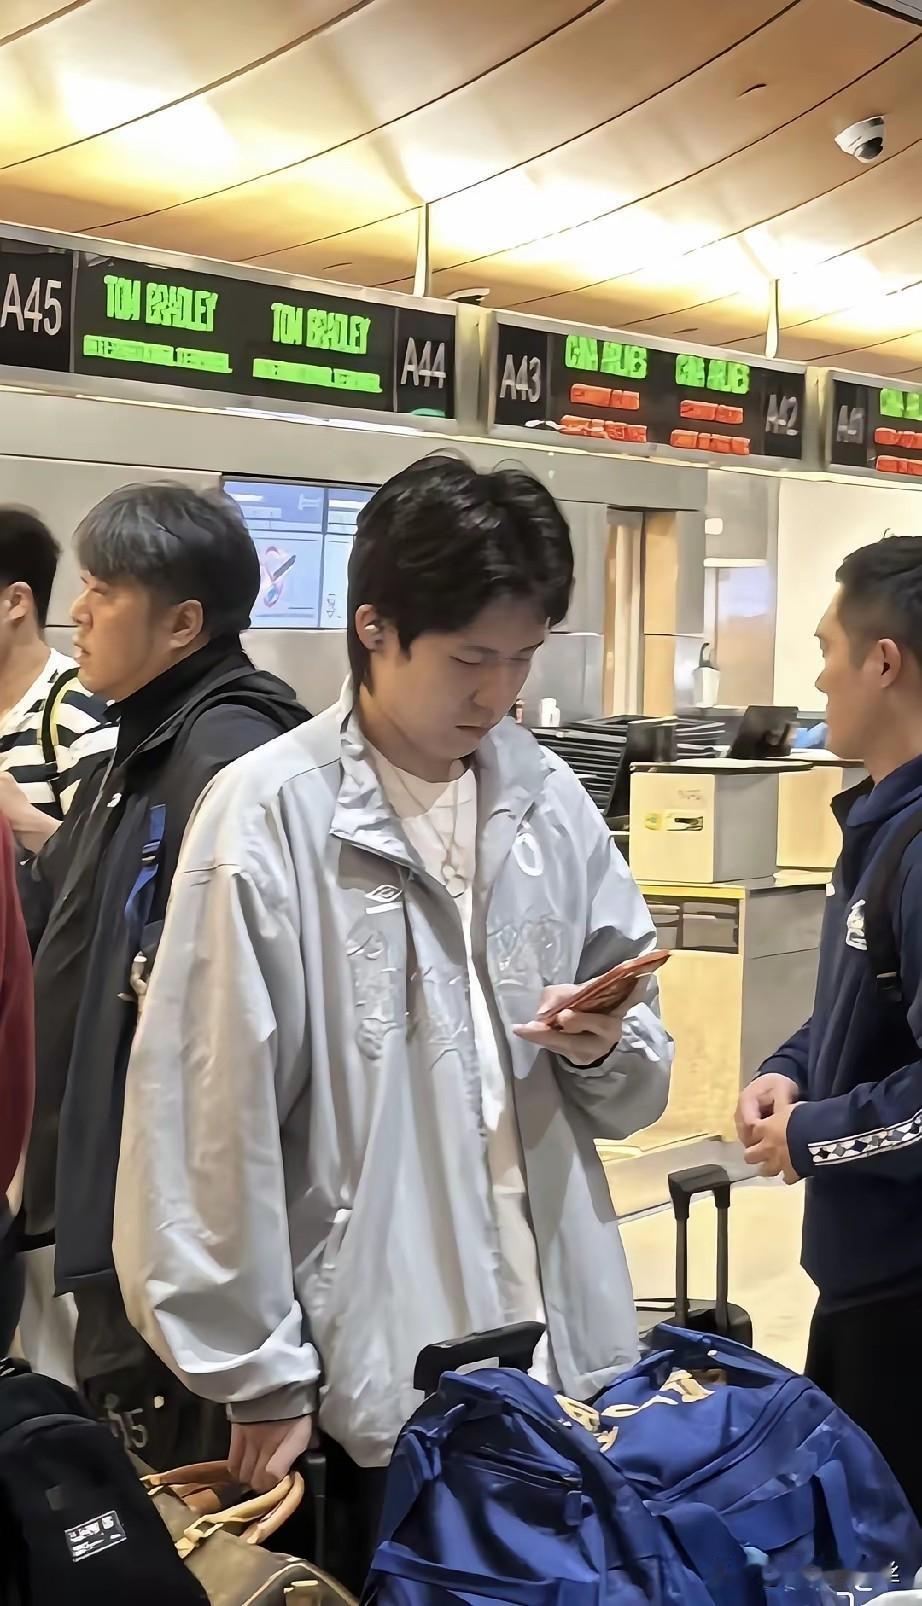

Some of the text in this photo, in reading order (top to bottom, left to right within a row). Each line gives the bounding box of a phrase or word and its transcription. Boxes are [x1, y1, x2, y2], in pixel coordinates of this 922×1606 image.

[0, 273, 62, 336] A45
[400, 337, 447, 389] A44
[499, 353, 542, 403] A43
